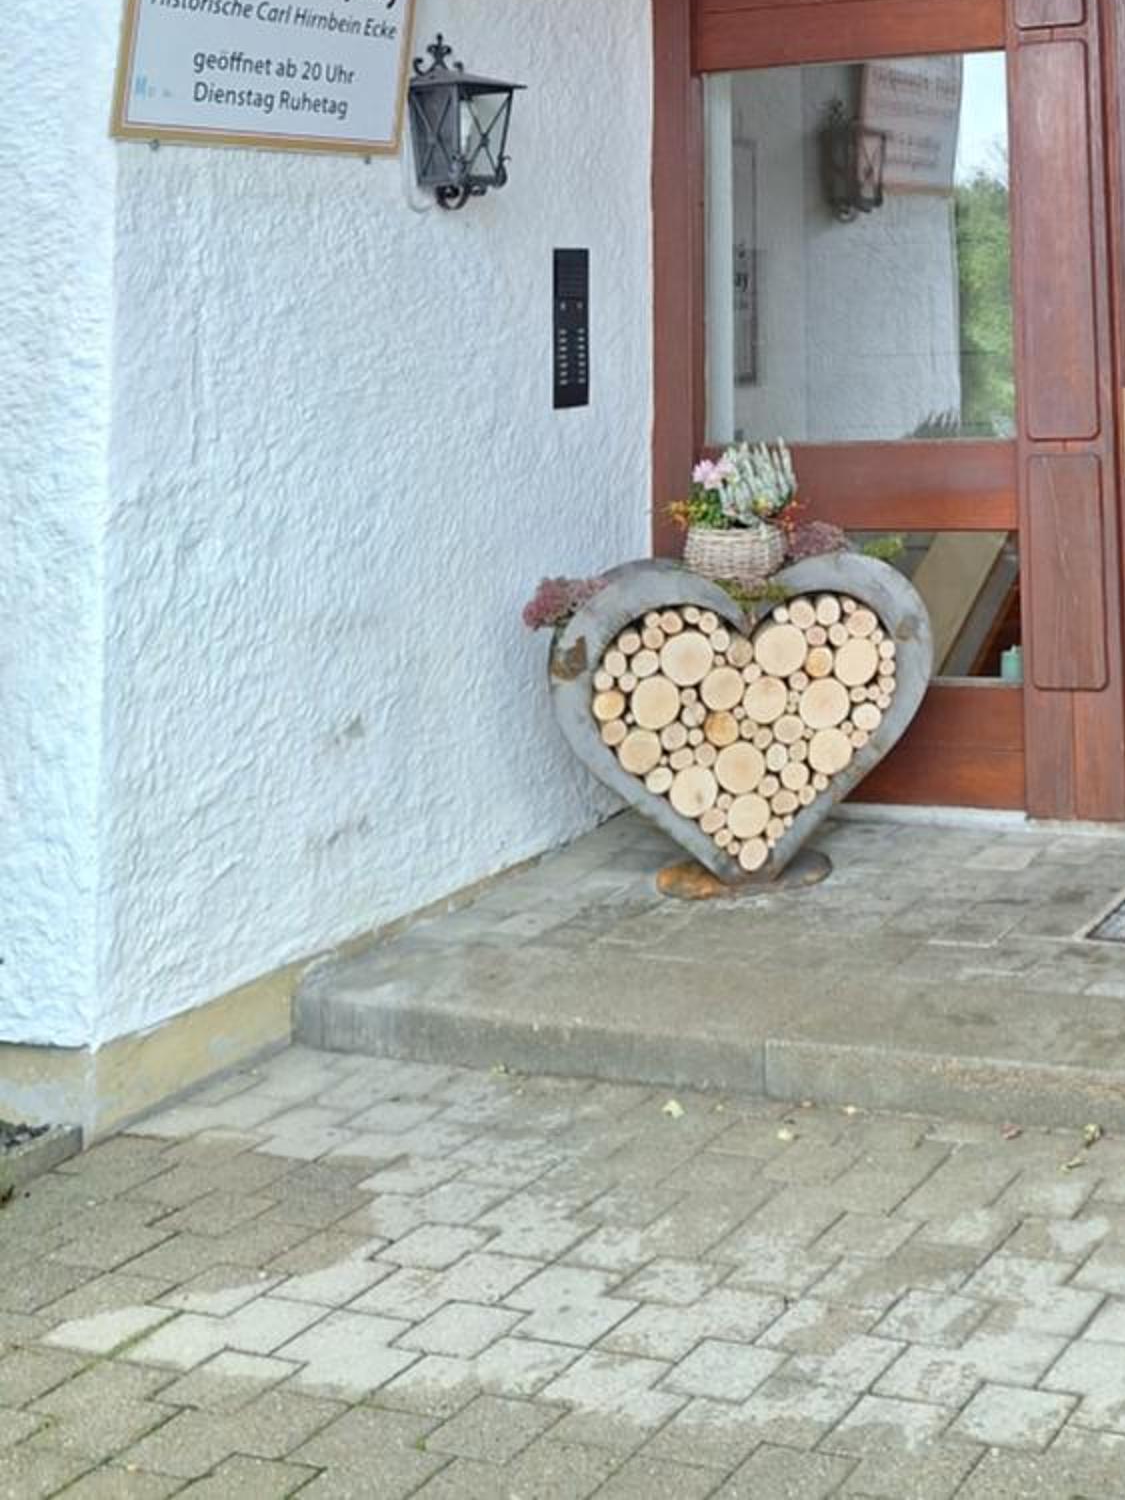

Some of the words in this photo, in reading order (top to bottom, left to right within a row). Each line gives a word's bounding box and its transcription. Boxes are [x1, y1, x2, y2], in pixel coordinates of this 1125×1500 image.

[256, 1, 291, 25] Carl
[294, 7, 361, 35] Hirnbein
[363, 18, 398, 40] Ecke
[193, 50, 271, 76] geöffnet
[275, 58, 298, 78] ab
[301, 60, 322, 81] 20
[325, 64, 356, 85] Uhr
[193, 81, 275, 115] Dienstag
[278, 90, 348, 121] Ruhetag
